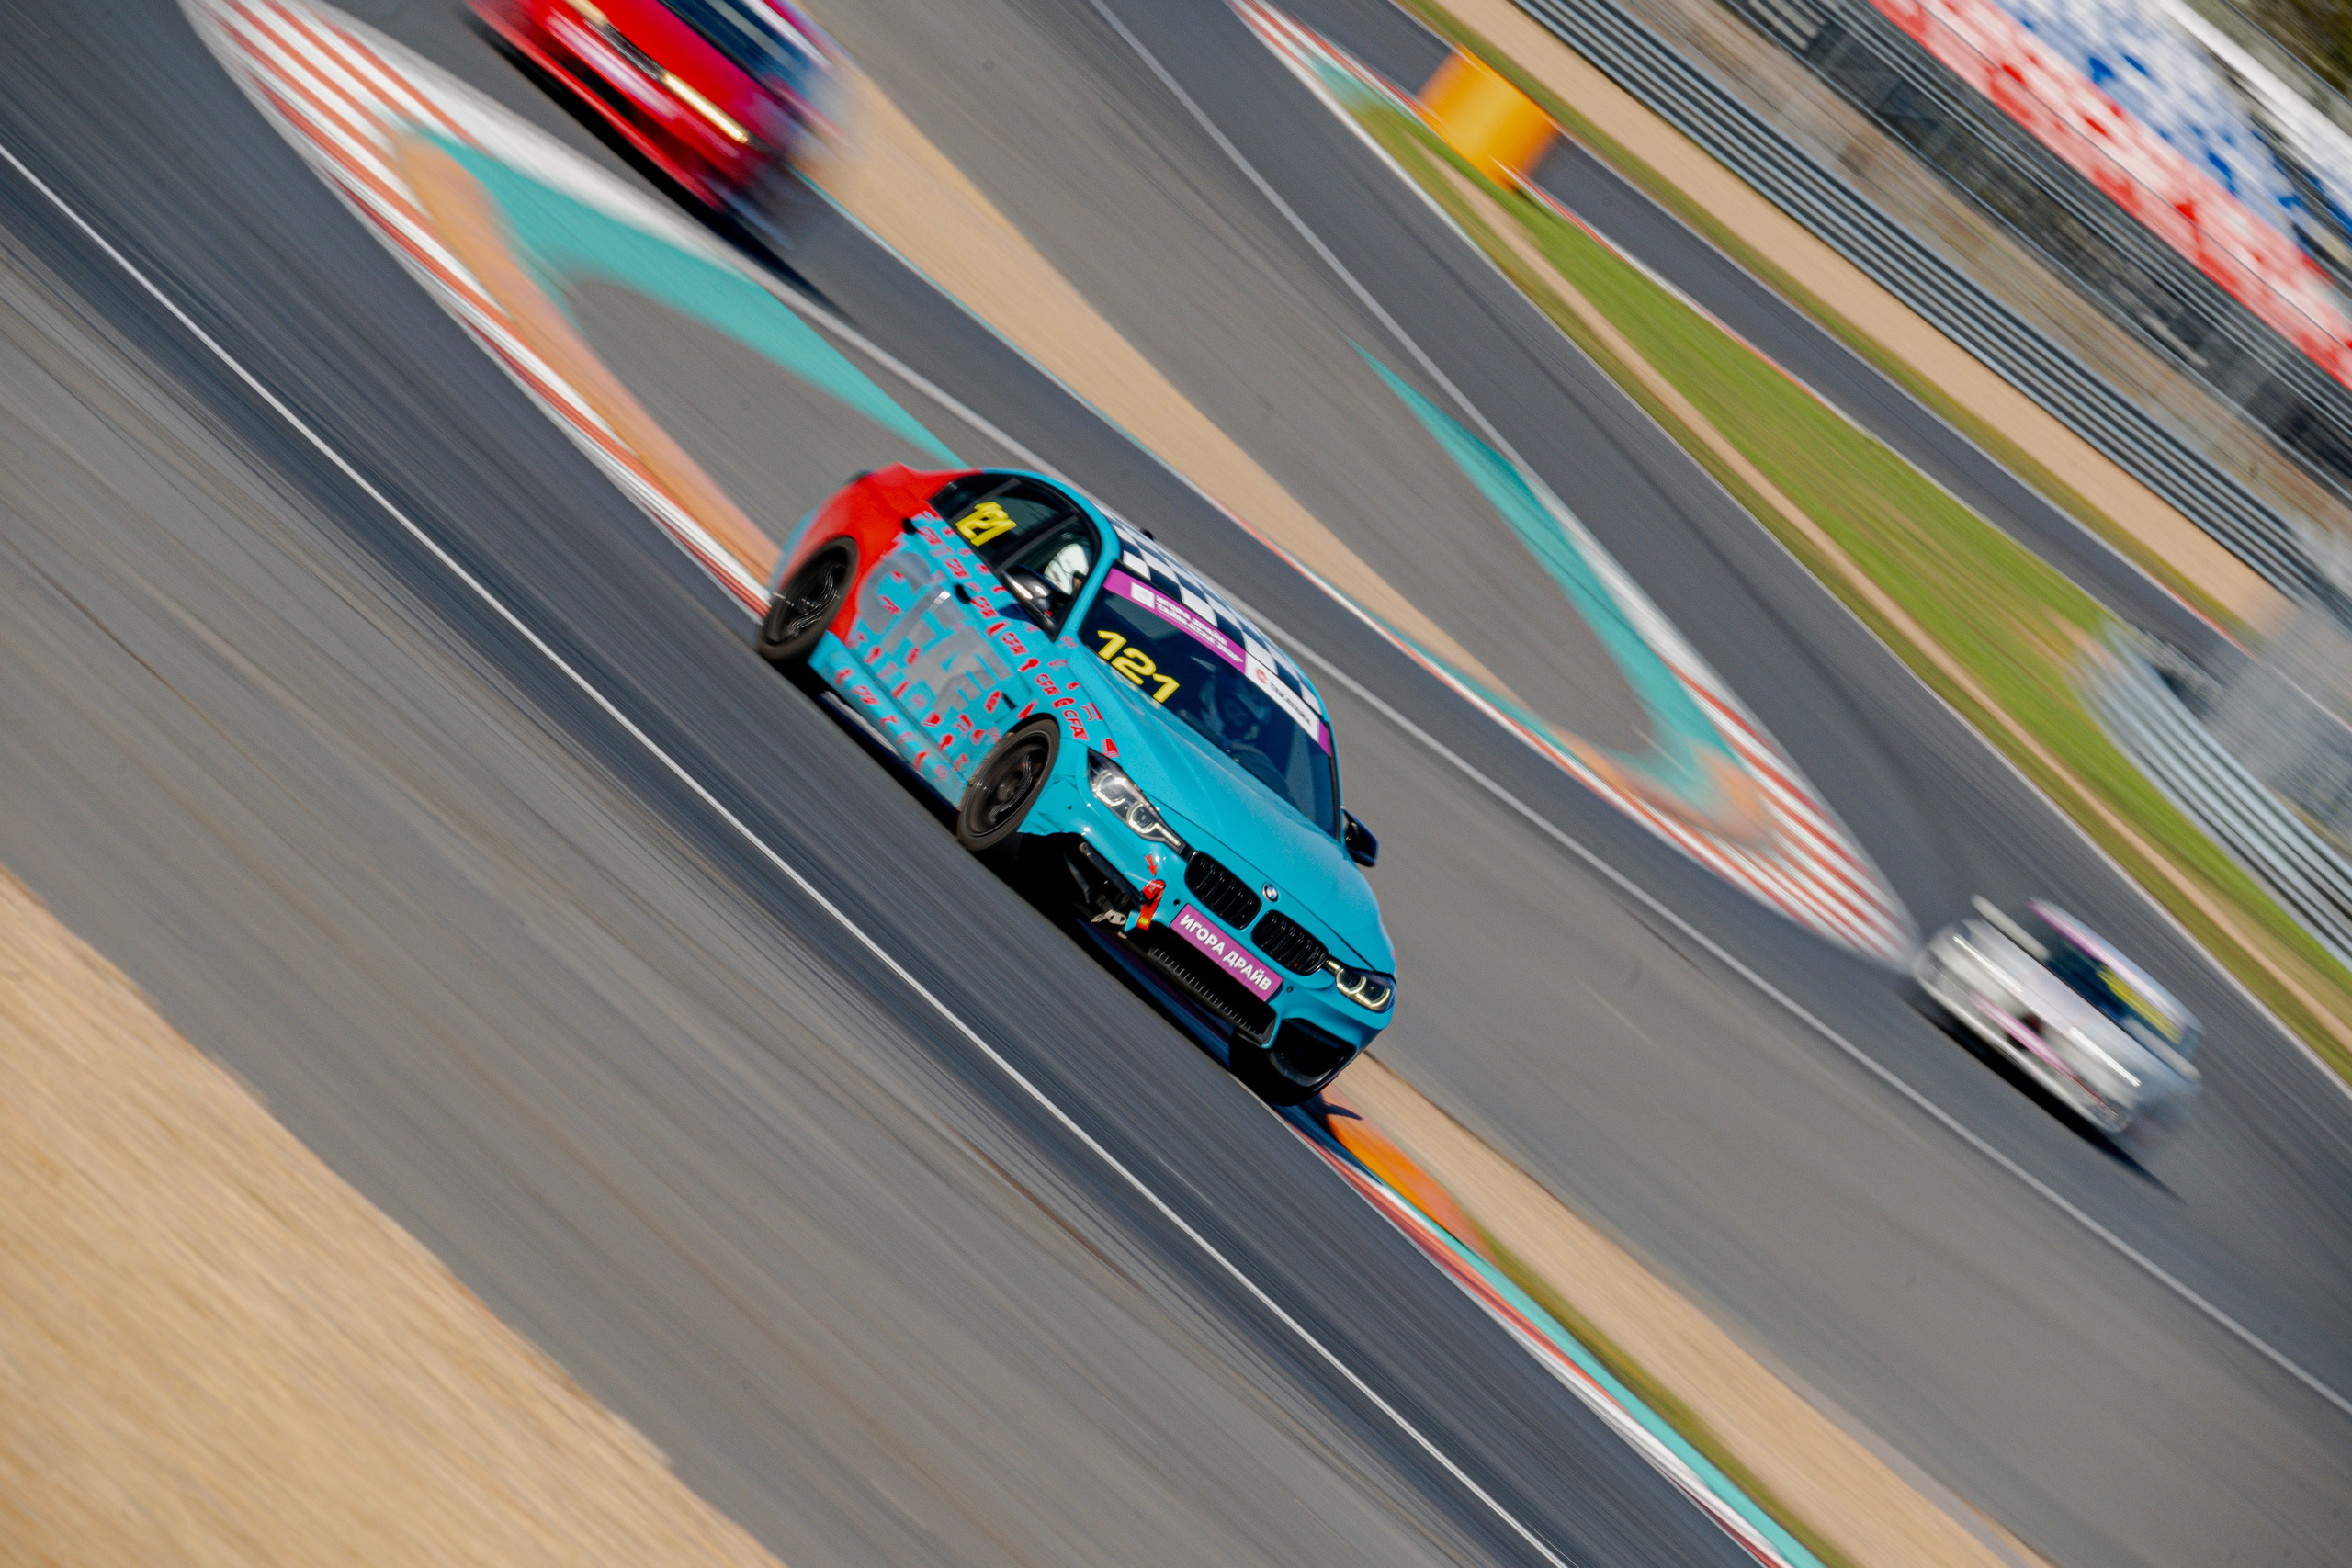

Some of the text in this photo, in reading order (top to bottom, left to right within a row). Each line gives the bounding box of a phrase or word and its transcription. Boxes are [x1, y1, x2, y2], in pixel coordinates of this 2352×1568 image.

[956, 502, 1017, 547] 121
[1097, 630, 1180, 704] 121
[1063, 708, 1090, 740] CFA
[1180, 913, 1273, 992] ИГОРА ДРАЙВ
